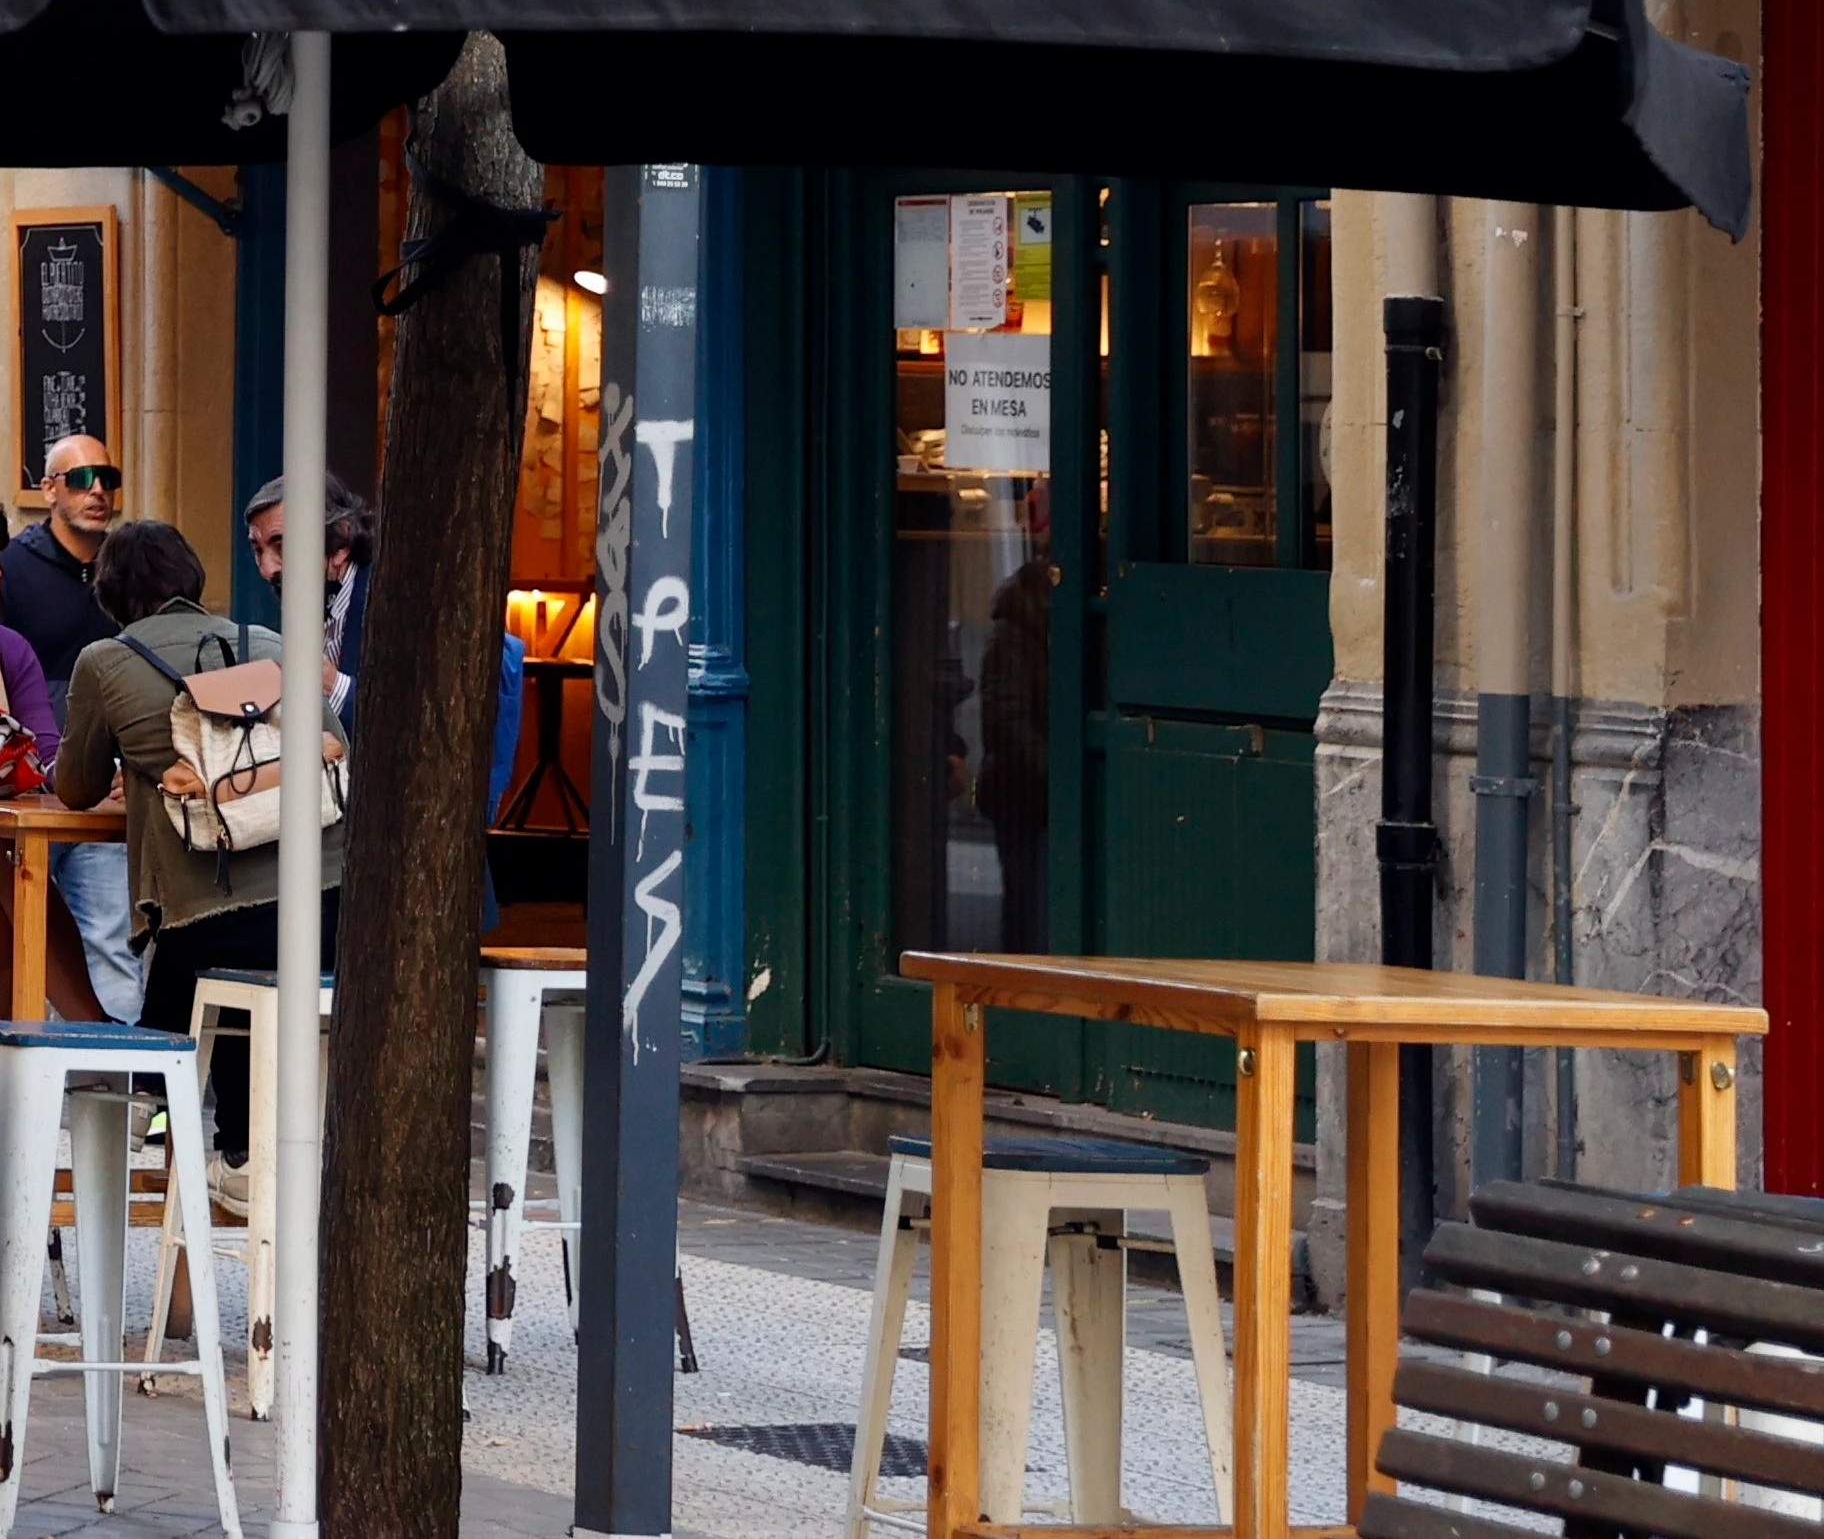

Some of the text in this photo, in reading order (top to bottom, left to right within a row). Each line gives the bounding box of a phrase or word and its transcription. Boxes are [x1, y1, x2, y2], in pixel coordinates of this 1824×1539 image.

[948, 369, 1051, 390] NO ATENDEMOS
[971, 398, 1026, 418] EN MESA
